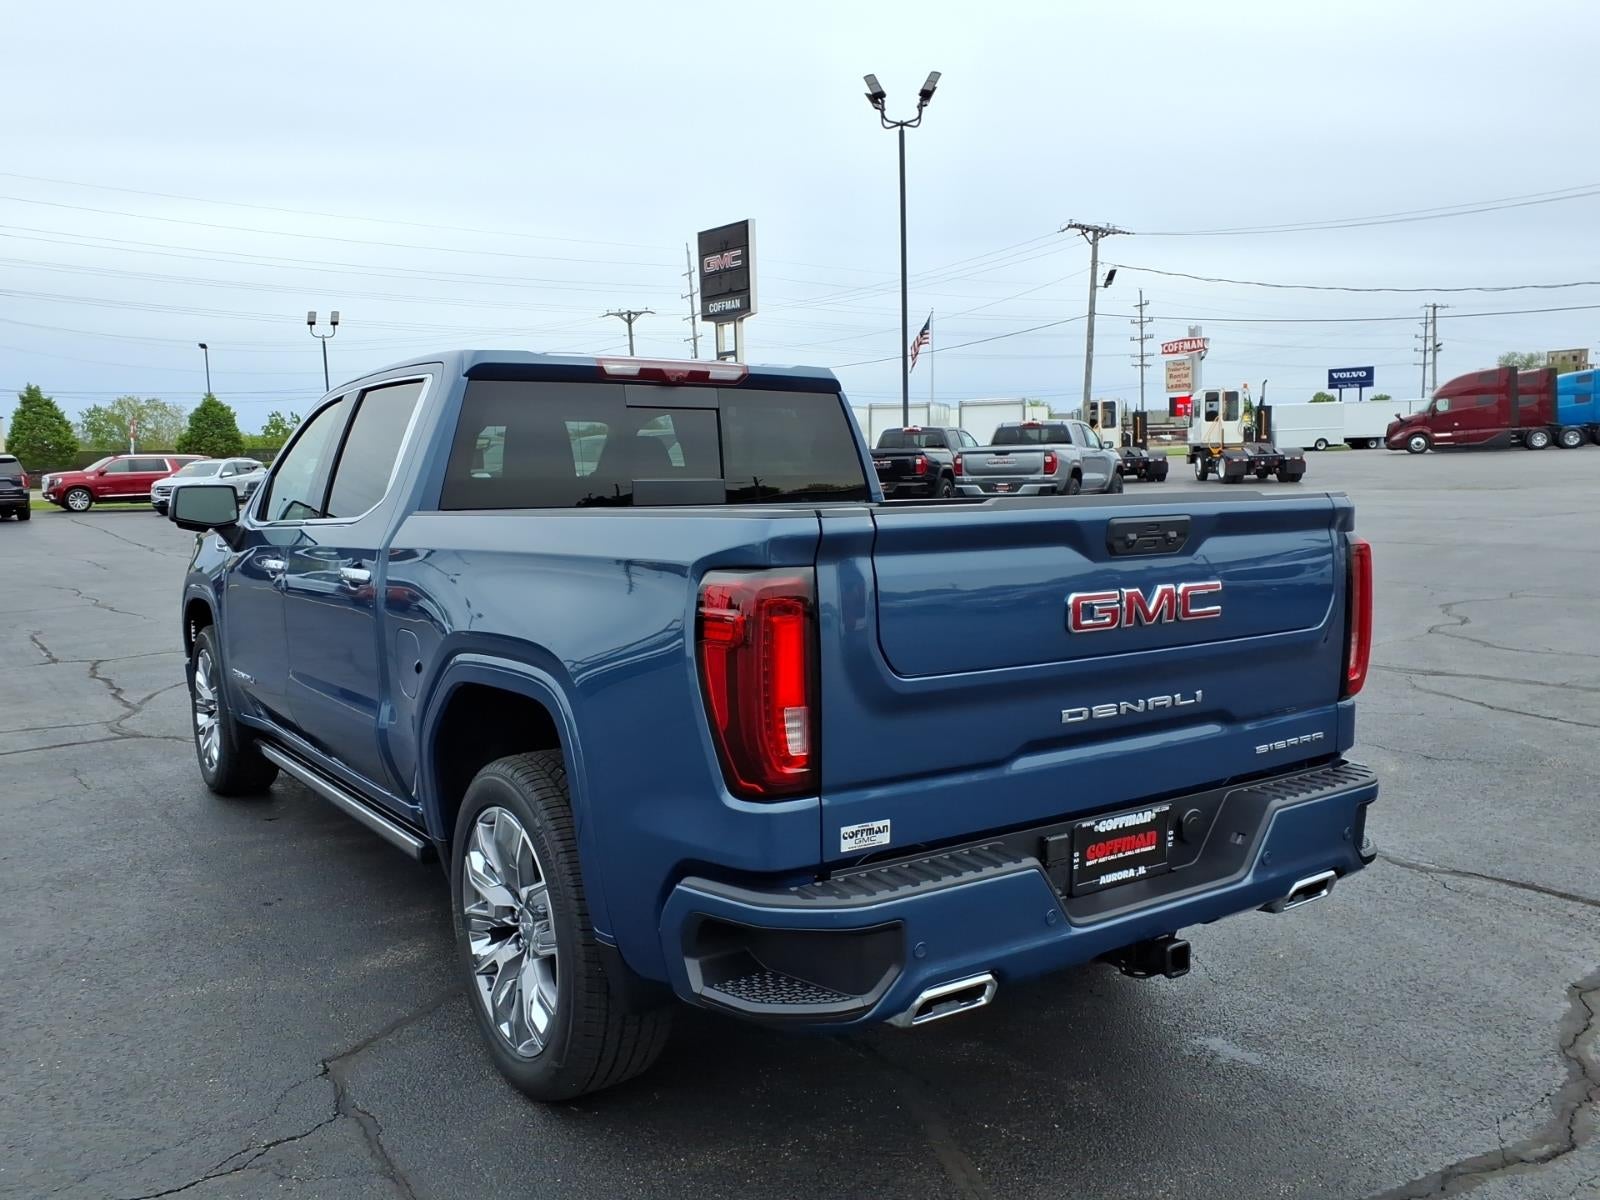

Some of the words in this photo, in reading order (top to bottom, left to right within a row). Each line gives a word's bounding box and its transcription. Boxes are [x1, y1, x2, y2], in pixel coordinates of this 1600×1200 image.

[704, 250, 742, 273] GMC
[709, 299, 741, 313] COFFMAN
[1163, 339, 1203, 353] COFFMAN
[1331, 370, 1367, 379] VOLVO
[1067, 580, 1222, 634] GMC
[1062, 690, 1203, 723] DENALI
[1255, 732, 1324, 754] SIERRA
[842, 825, 889, 840] COFFMAN
[855, 835, 877, 845] GMC
[1086, 831, 1157, 860] COFFMAN
[1099, 868, 1135, 885] AURORA
